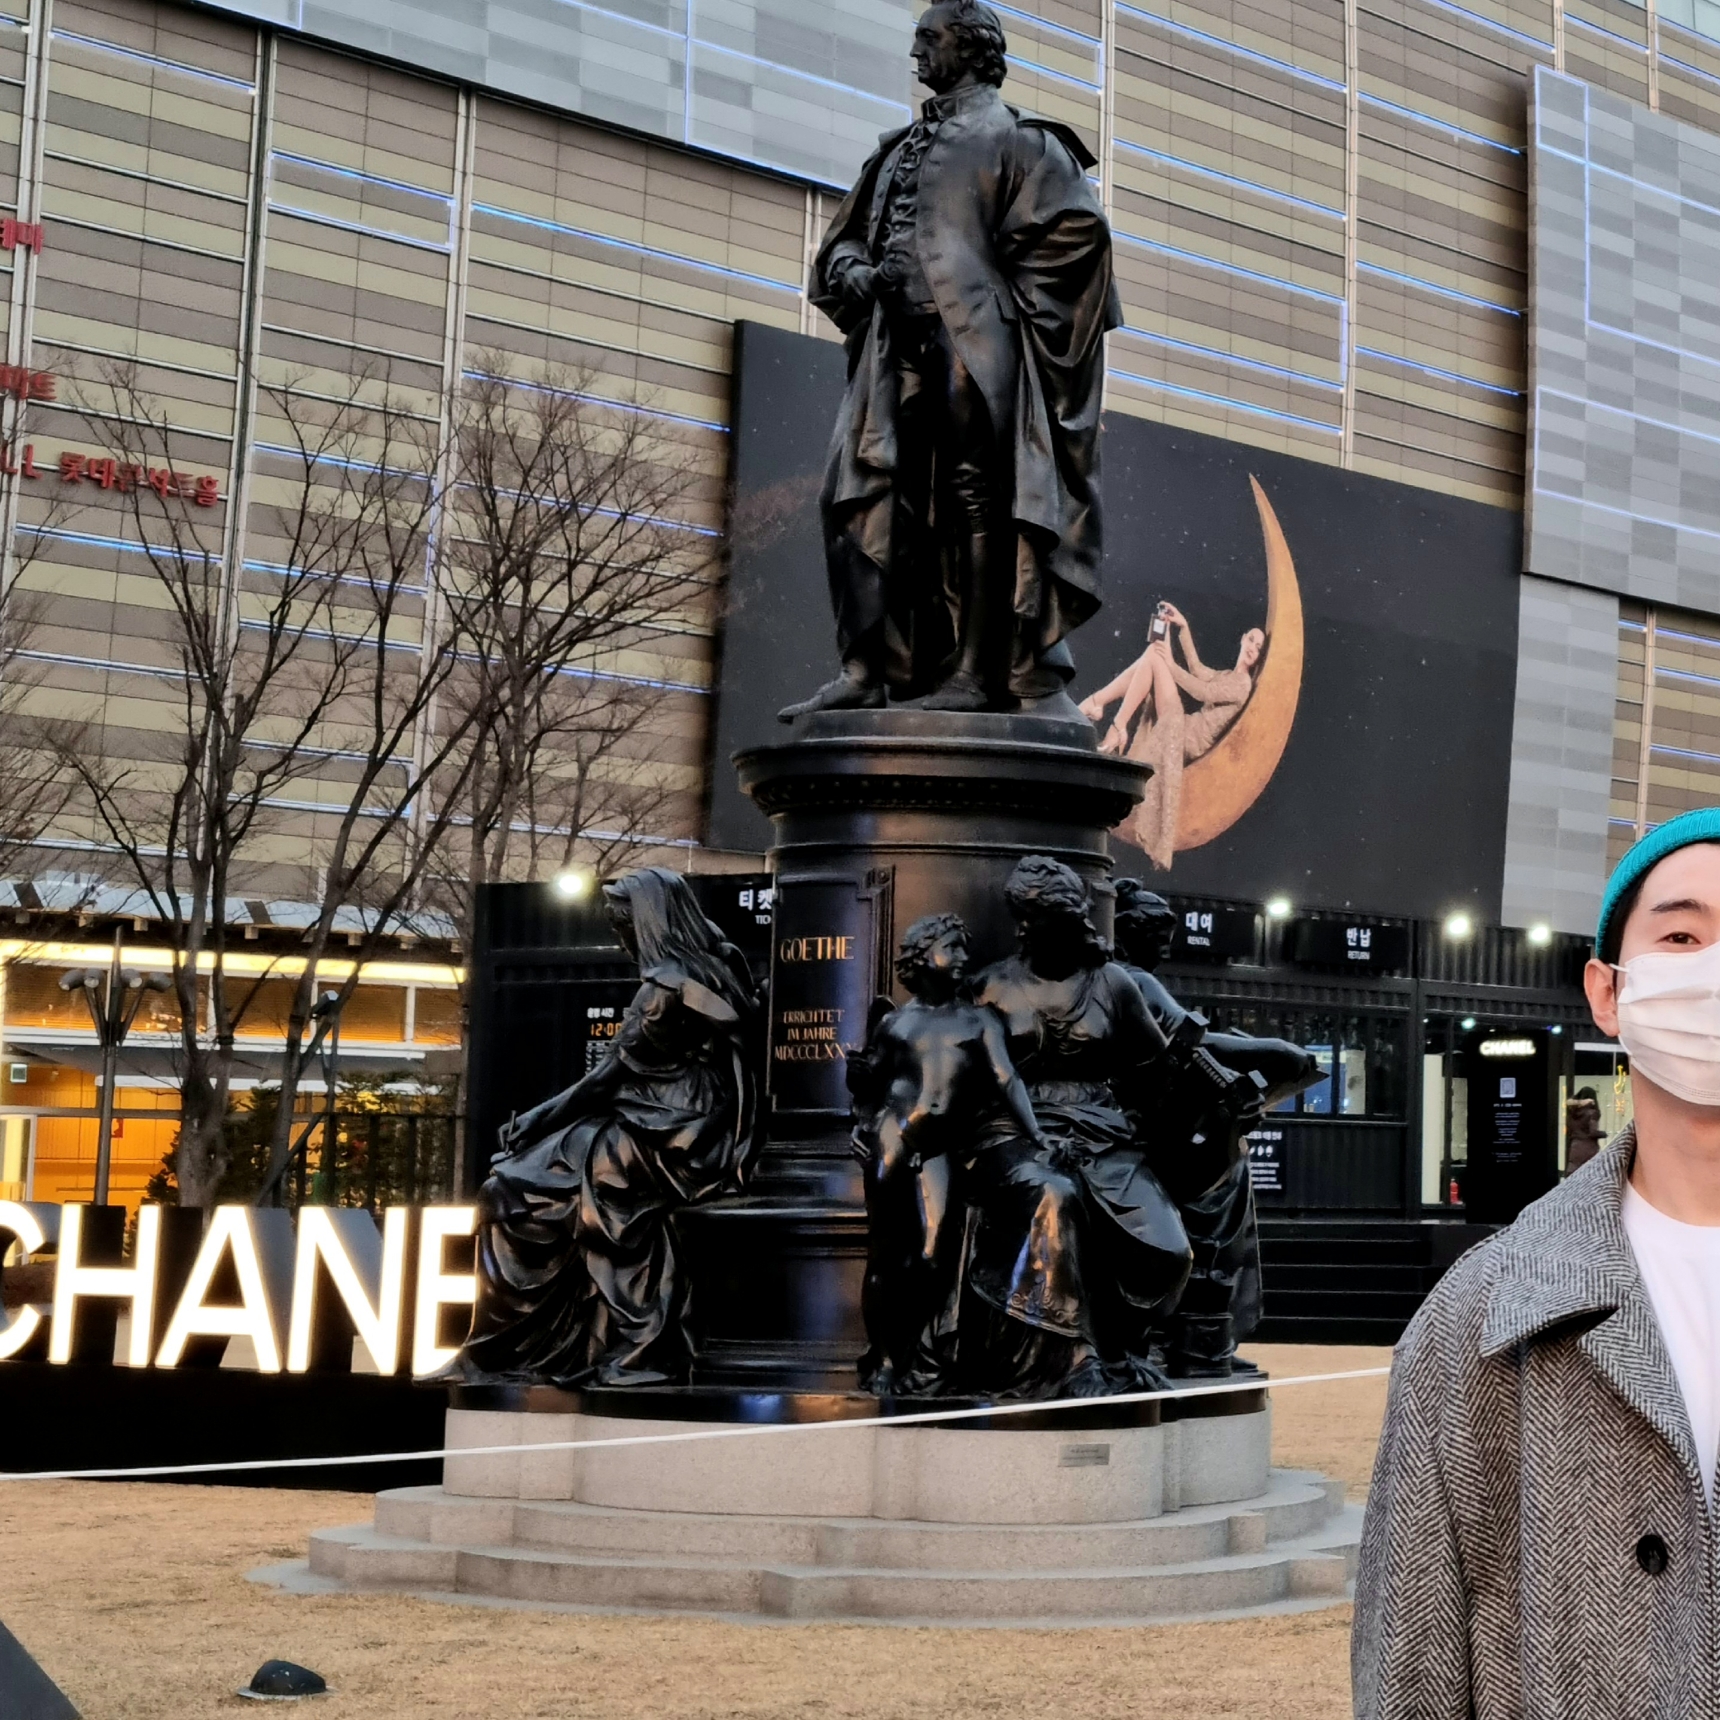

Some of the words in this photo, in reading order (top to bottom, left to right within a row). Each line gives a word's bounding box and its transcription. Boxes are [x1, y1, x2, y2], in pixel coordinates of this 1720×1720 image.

[739, 888, 773, 910] 티켓
[755, 914, 772, 925] TIC
[1185, 910, 1213, 933] 대여
[1187, 935, 1211, 947] RENTAL
[1346, 926, 1372, 948] 반납
[780, 936, 855, 963] GOETHE
[1347, 949, 1371, 960] RETURN
[783, 1009, 845, 1024] ERRICHTET
[786, 1027, 800, 1041] IM
[802, 1026, 838, 1041] JAHRE
[1479, 1039, 1536, 1056] CHANEL
